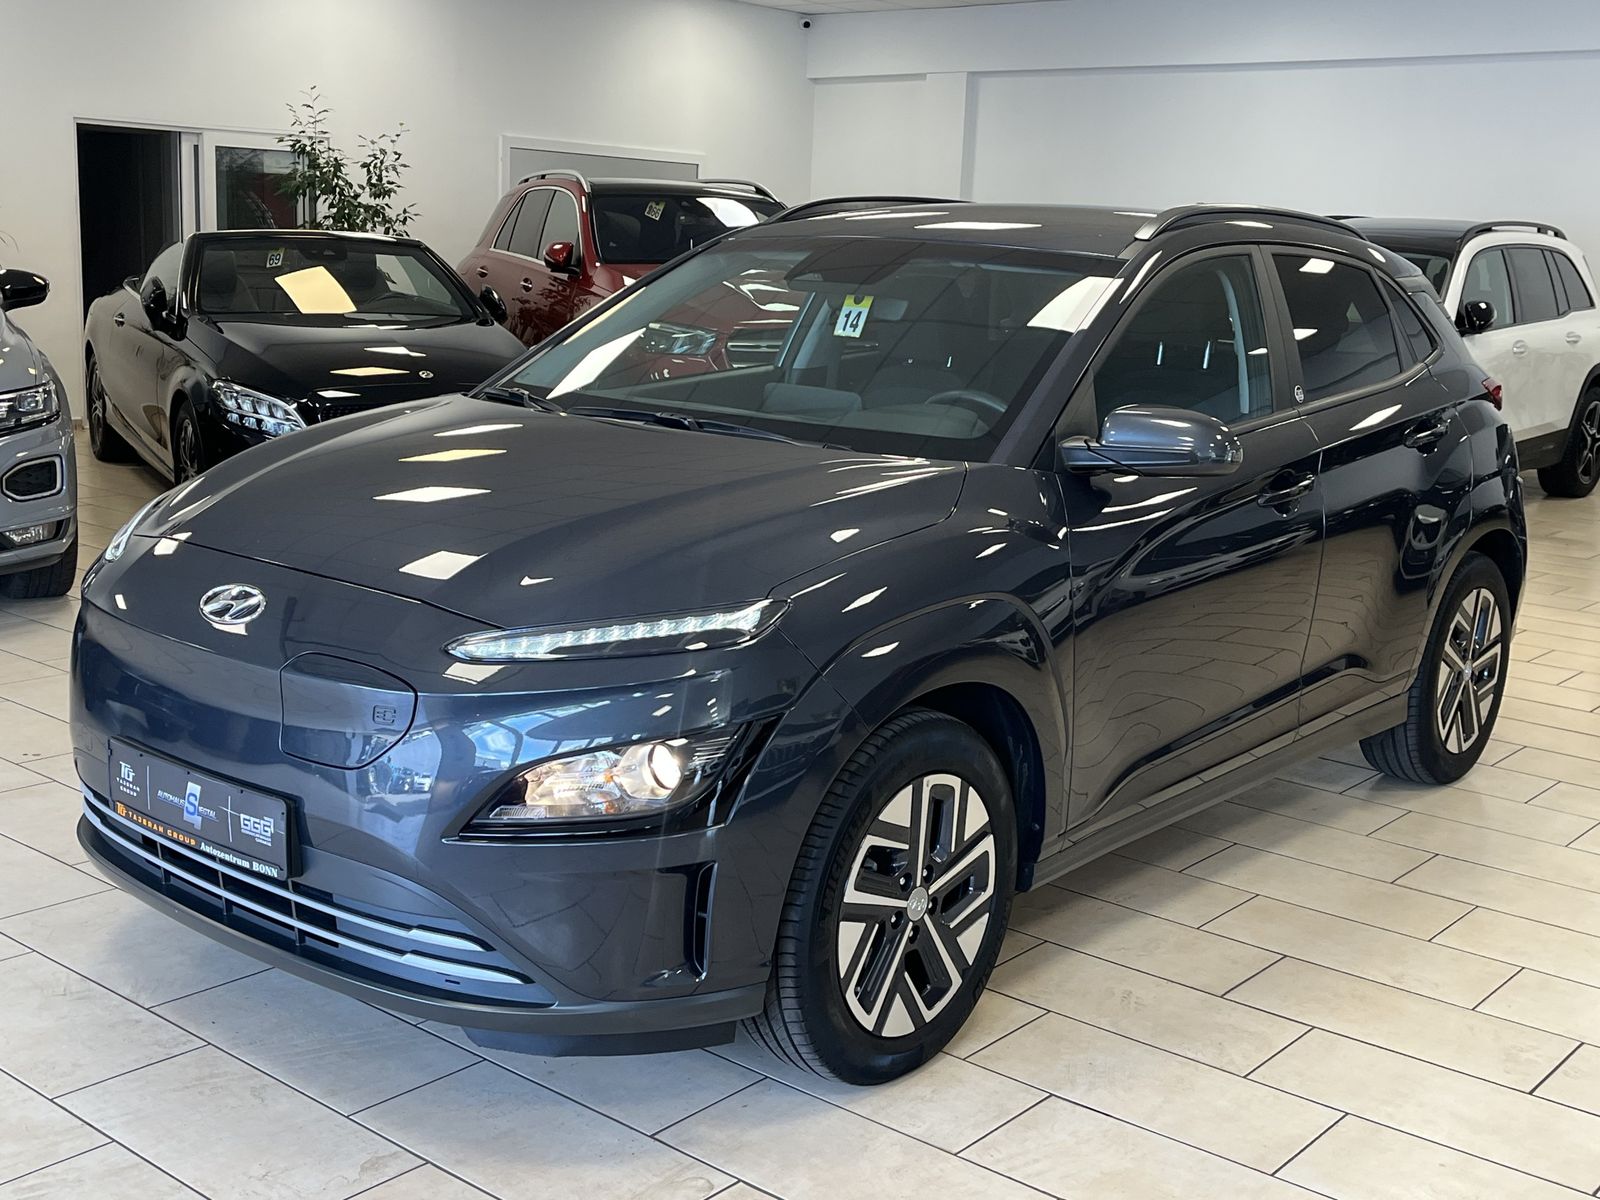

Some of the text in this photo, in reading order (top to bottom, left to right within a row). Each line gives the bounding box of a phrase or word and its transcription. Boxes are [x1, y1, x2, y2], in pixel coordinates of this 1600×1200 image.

[268, 253, 281, 266] 69
[842, 309, 863, 333] 14
[240, 813, 273, 837] GGG
[167, 829, 196, 846] GROUP
[200, 842, 250, 868] Autozentrum
[252, 861, 278, 878] BONN
